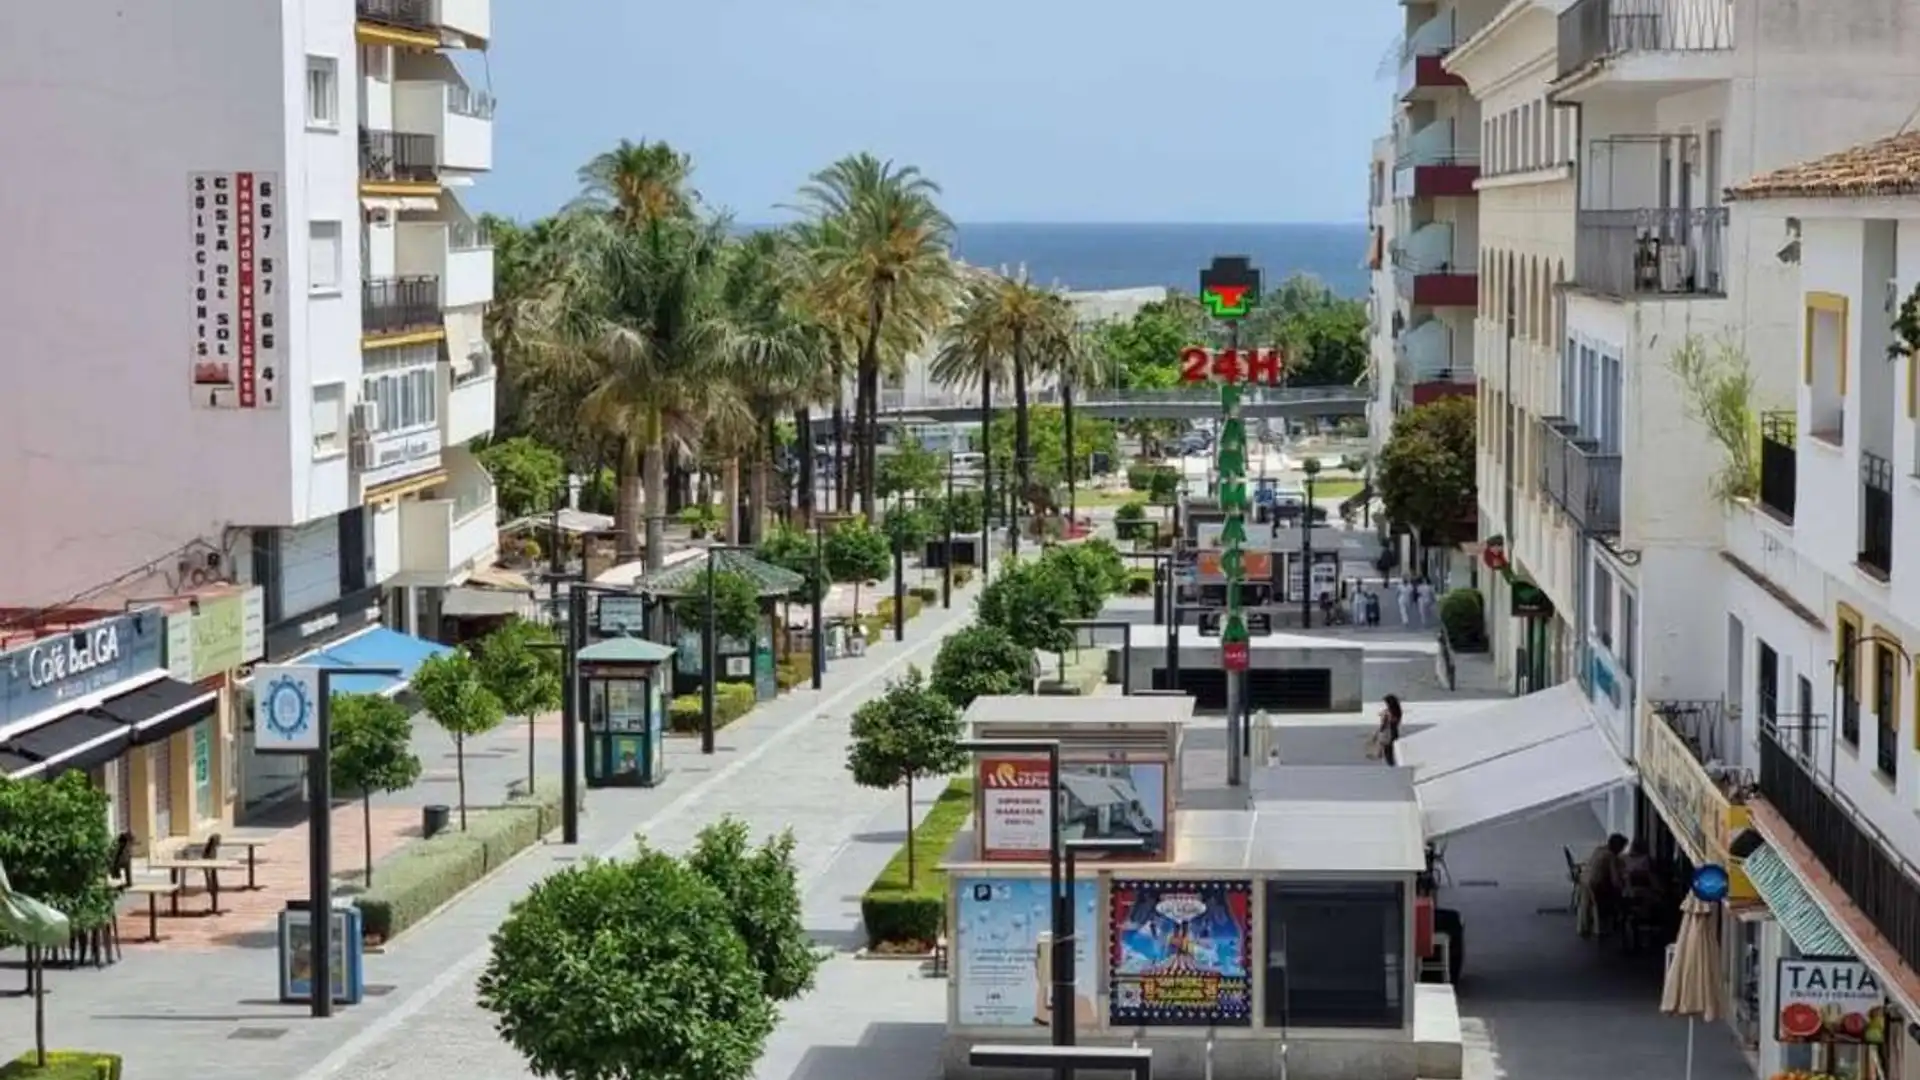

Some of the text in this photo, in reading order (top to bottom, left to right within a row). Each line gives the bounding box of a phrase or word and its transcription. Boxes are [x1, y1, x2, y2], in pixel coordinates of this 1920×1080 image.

[194, 176, 206, 355] SOLUCIONES
[215, 177, 229, 354] COSTA DEL SOL
[1180, 347, 1282, 387] 24H
[29, 645, 66, 688] Café
[1787, 965, 1877, 990] TAHA
